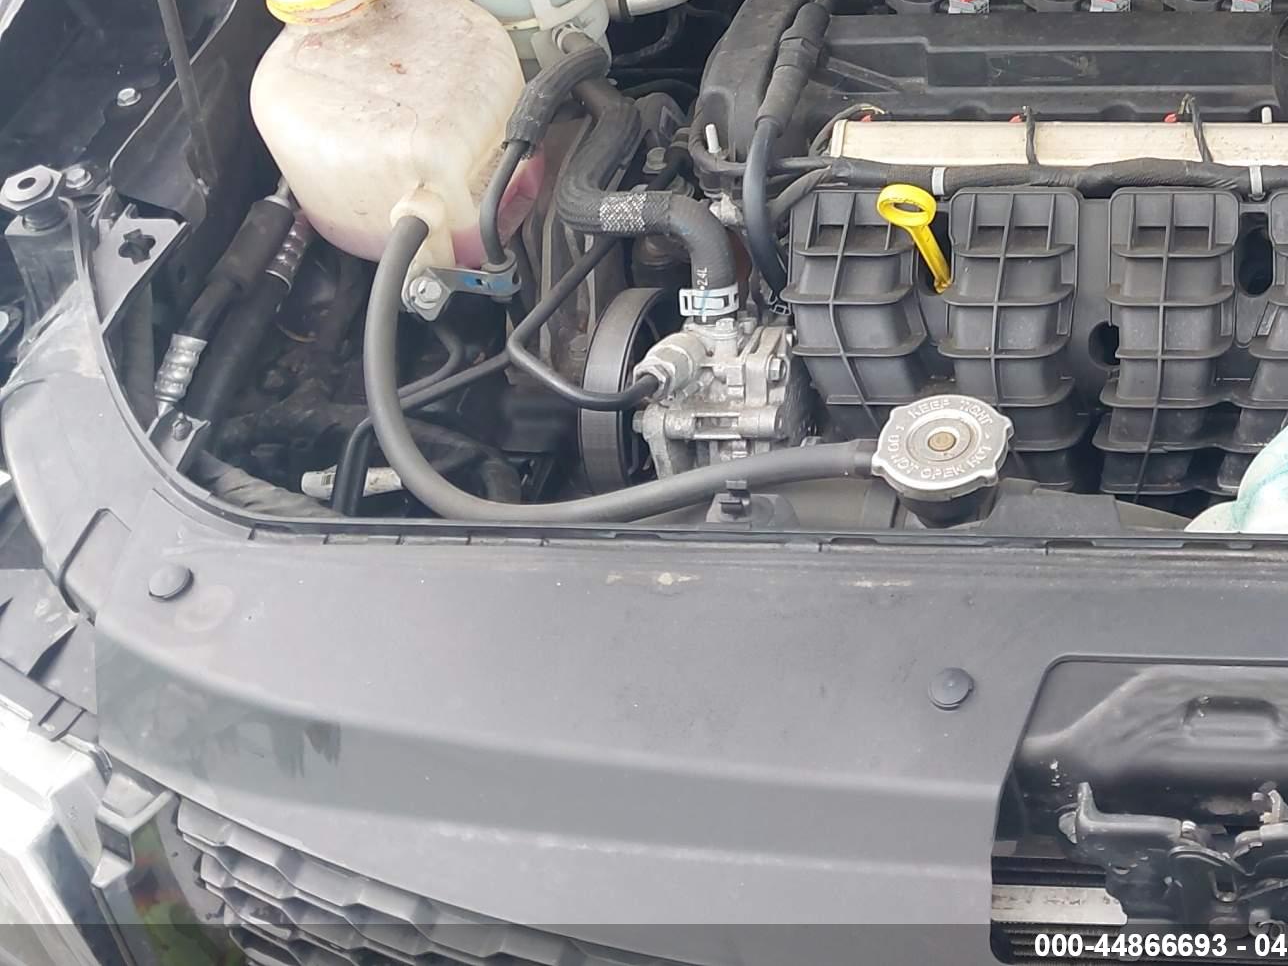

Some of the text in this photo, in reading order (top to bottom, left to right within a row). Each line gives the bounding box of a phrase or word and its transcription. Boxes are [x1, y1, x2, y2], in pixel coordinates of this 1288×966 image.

[908, 398, 993, 426] KEEP TIGHT
[920, 465, 966, 480] OPEN
[966, 445, 993, 468] HOT
